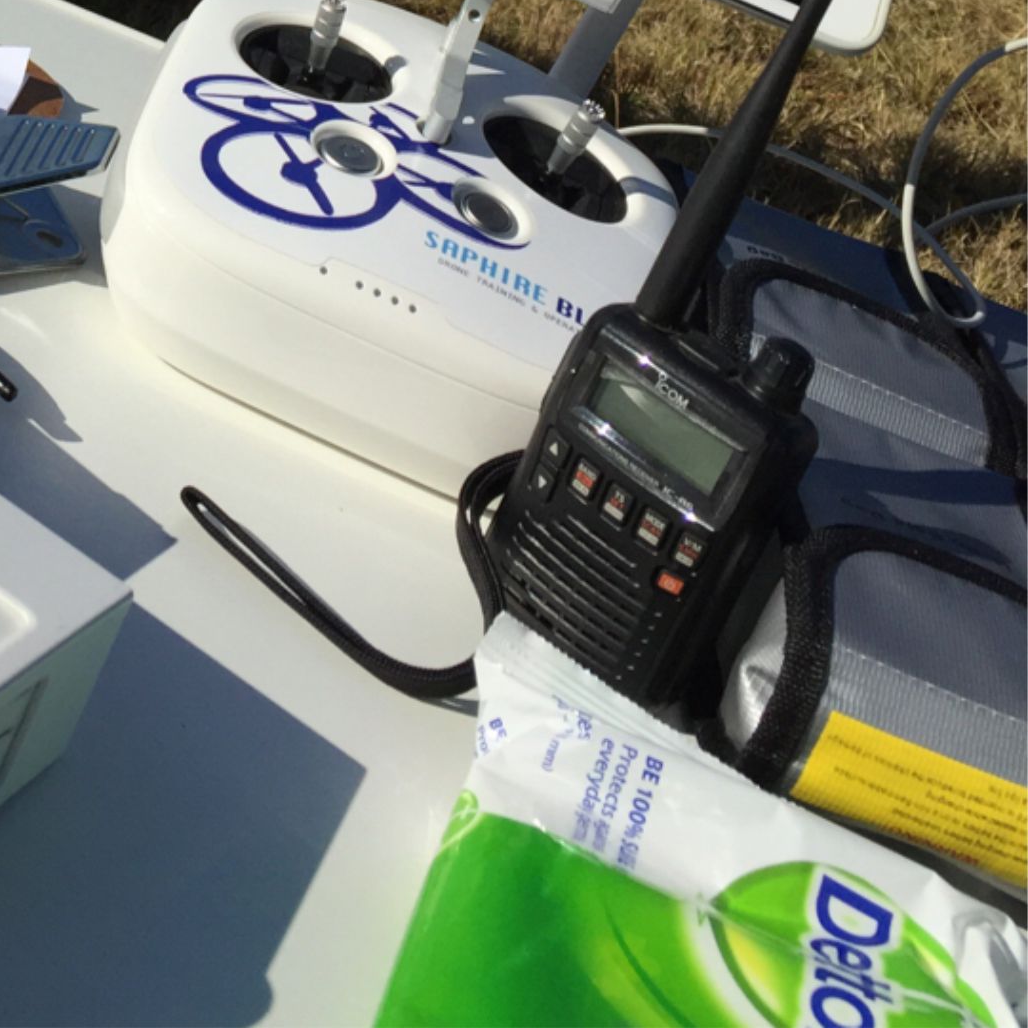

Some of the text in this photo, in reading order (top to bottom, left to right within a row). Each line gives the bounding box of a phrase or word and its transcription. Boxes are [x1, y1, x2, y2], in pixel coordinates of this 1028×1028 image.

[423, 229, 585, 327] SAPHIRE BL
[437, 256, 470, 277] DRONE
[476, 275, 526, 307] TRAINING
[601, 743, 639, 819] Protects
[642, 755, 664, 786] BE
[624, 788, 654, 840] 100%
[810, 873, 894, 1028] Detto
